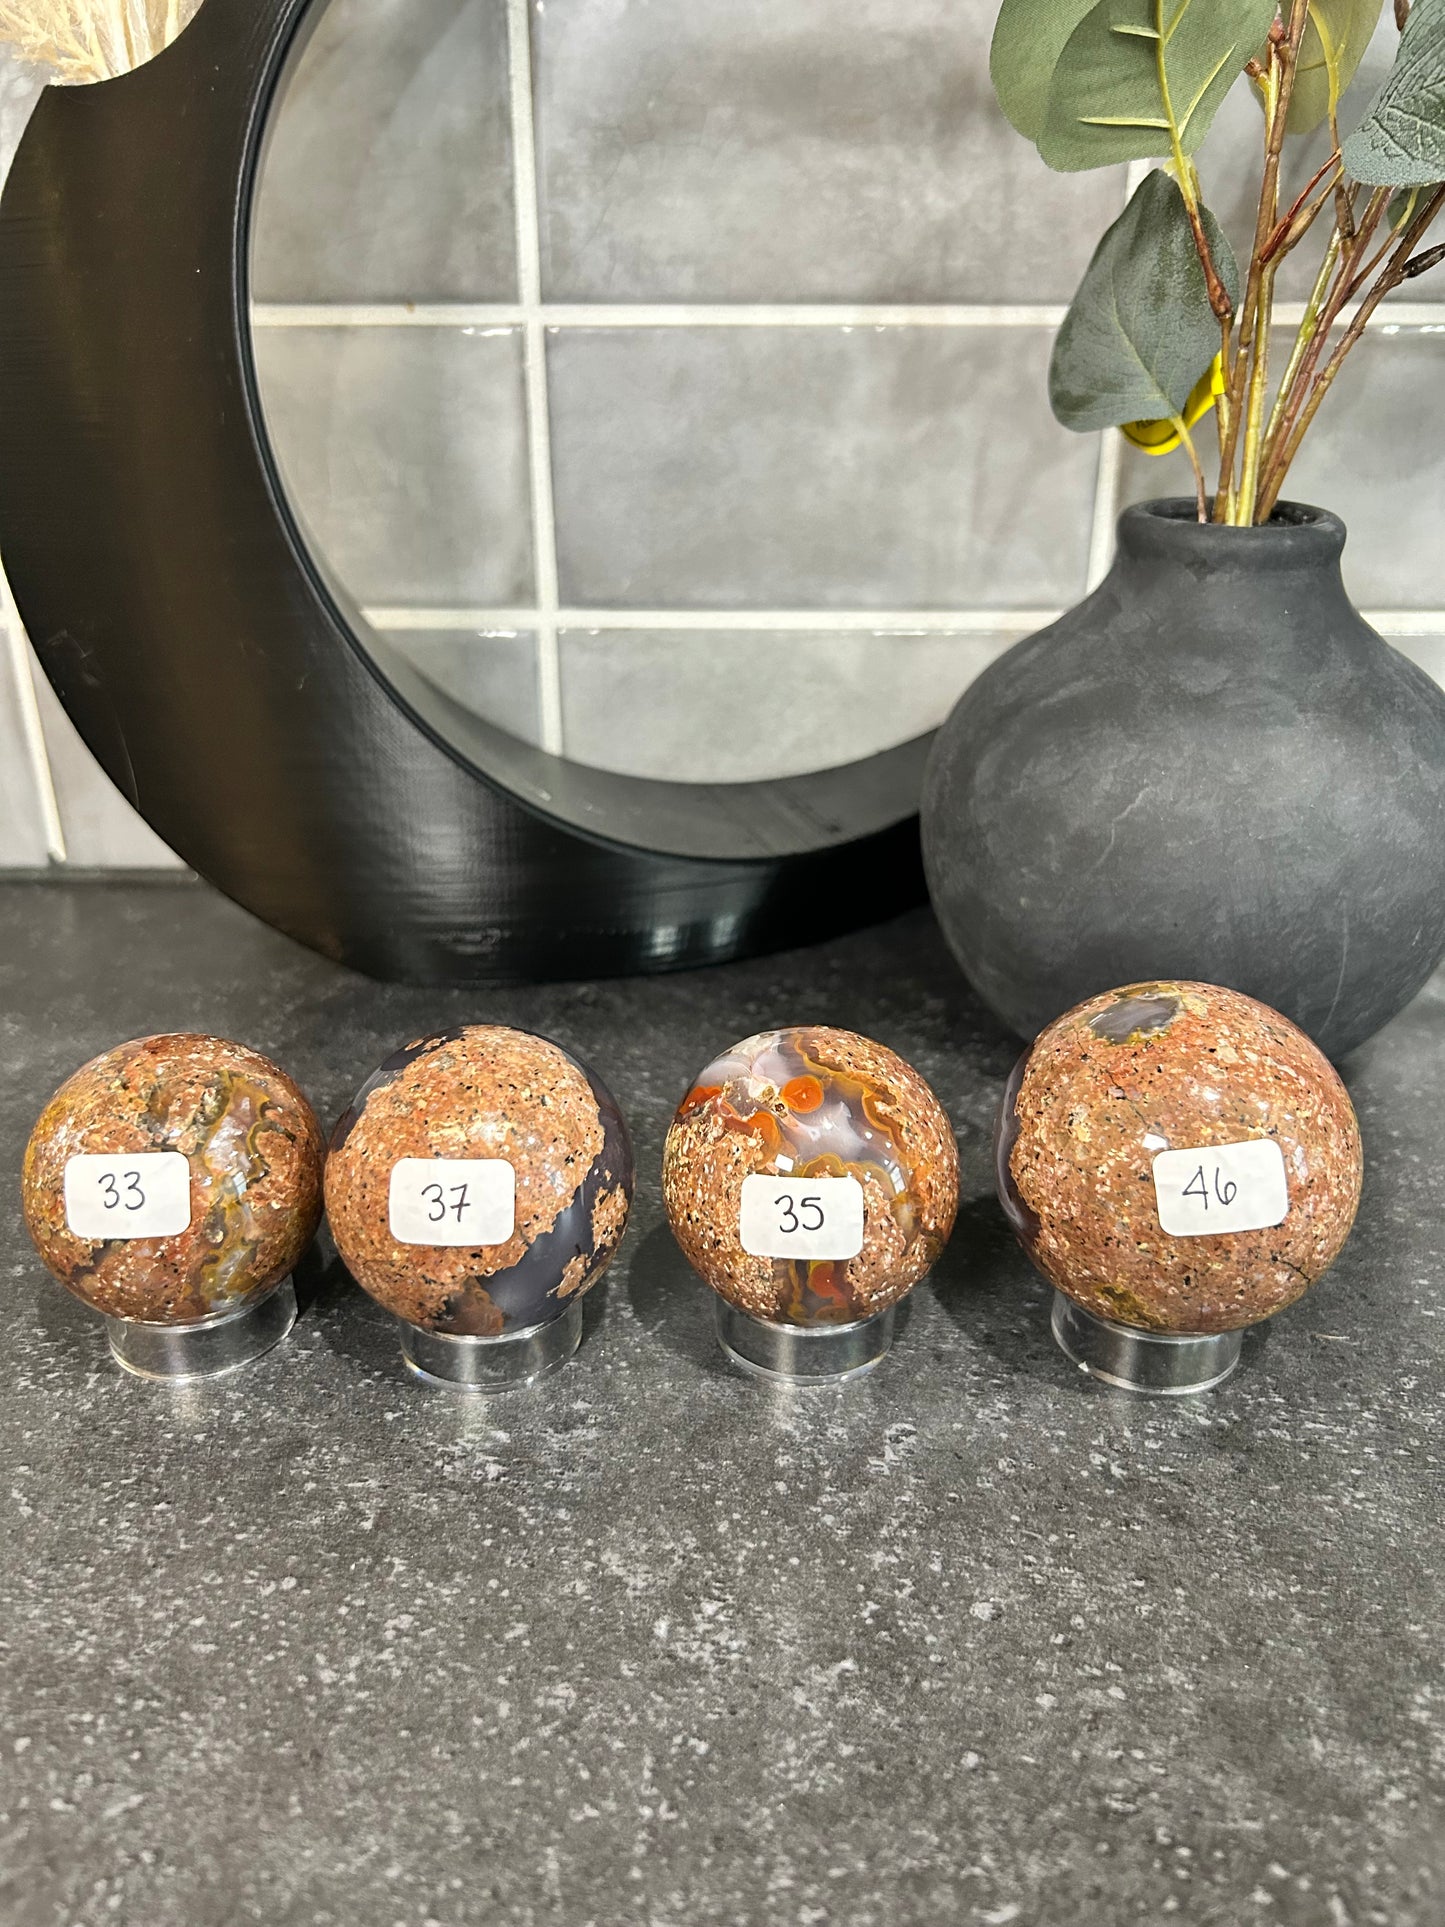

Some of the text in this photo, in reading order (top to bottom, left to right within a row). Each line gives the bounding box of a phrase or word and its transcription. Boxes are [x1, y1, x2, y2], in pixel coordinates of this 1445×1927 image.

[98, 1171, 145, 1211] 33
[421, 1183, 471, 1223] 37
[1182, 1165, 1237, 1210] 46
[774, 1194, 825, 1234] 35
